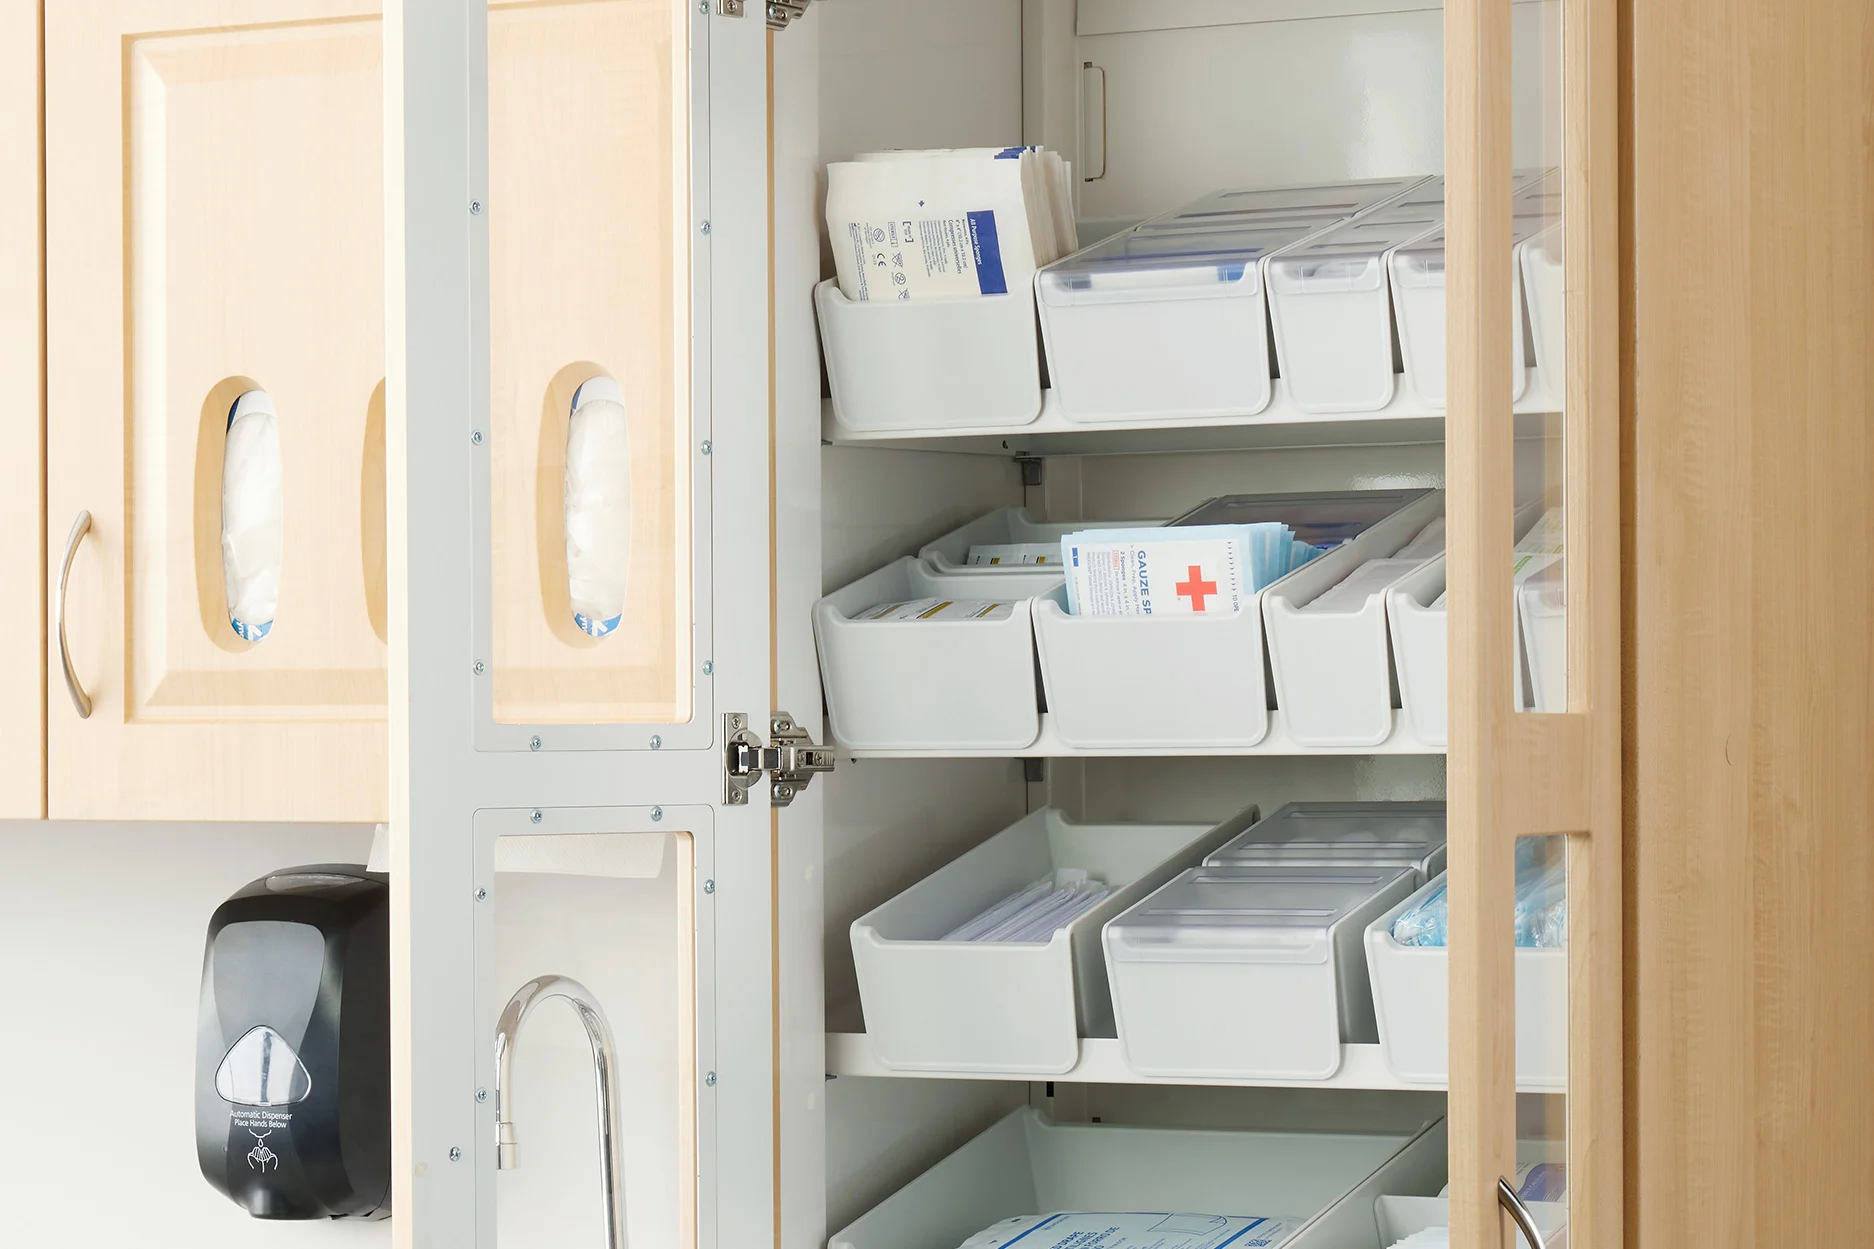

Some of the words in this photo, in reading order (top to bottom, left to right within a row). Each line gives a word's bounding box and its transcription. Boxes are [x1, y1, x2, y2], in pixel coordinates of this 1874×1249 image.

[971, 226, 979, 244] Purpose
[948, 220, 956, 247] Compresses
[953, 247, 962, 274] universelles
[974, 245, 982, 265] Sponges
[1137, 550, 1150, 596] GAUZE
[230, 1110, 261, 1119] Automatic
[262, 1111, 293, 1120] Dispenser
